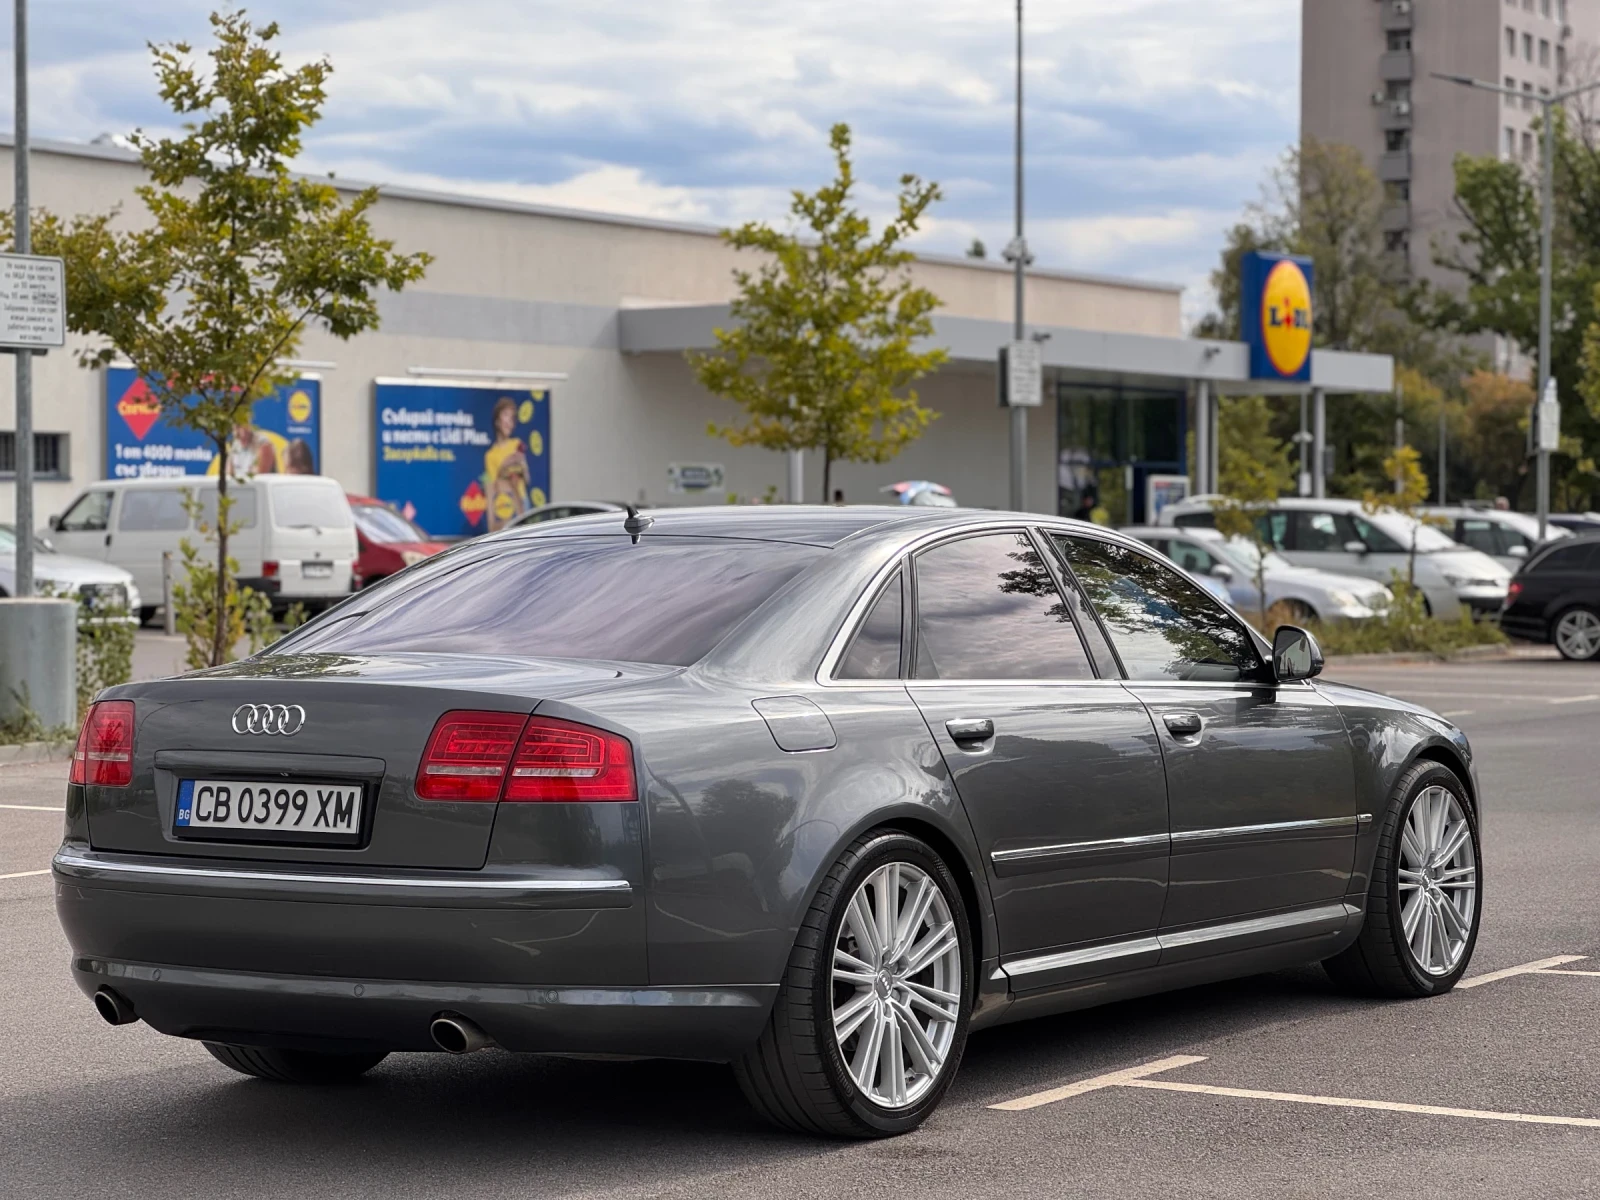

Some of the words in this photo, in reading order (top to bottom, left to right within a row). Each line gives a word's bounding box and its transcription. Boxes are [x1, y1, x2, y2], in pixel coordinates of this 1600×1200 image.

[382, 407, 434, 428] Събирай
[382, 430, 392, 444] и
[440, 427, 461, 445] Lidl
[115, 443, 122, 459] 1
[178, 809, 190, 820] BG
[195, 786, 231, 823] CB
[237, 787, 308, 826] 0399
[312, 790, 356, 829] XM
